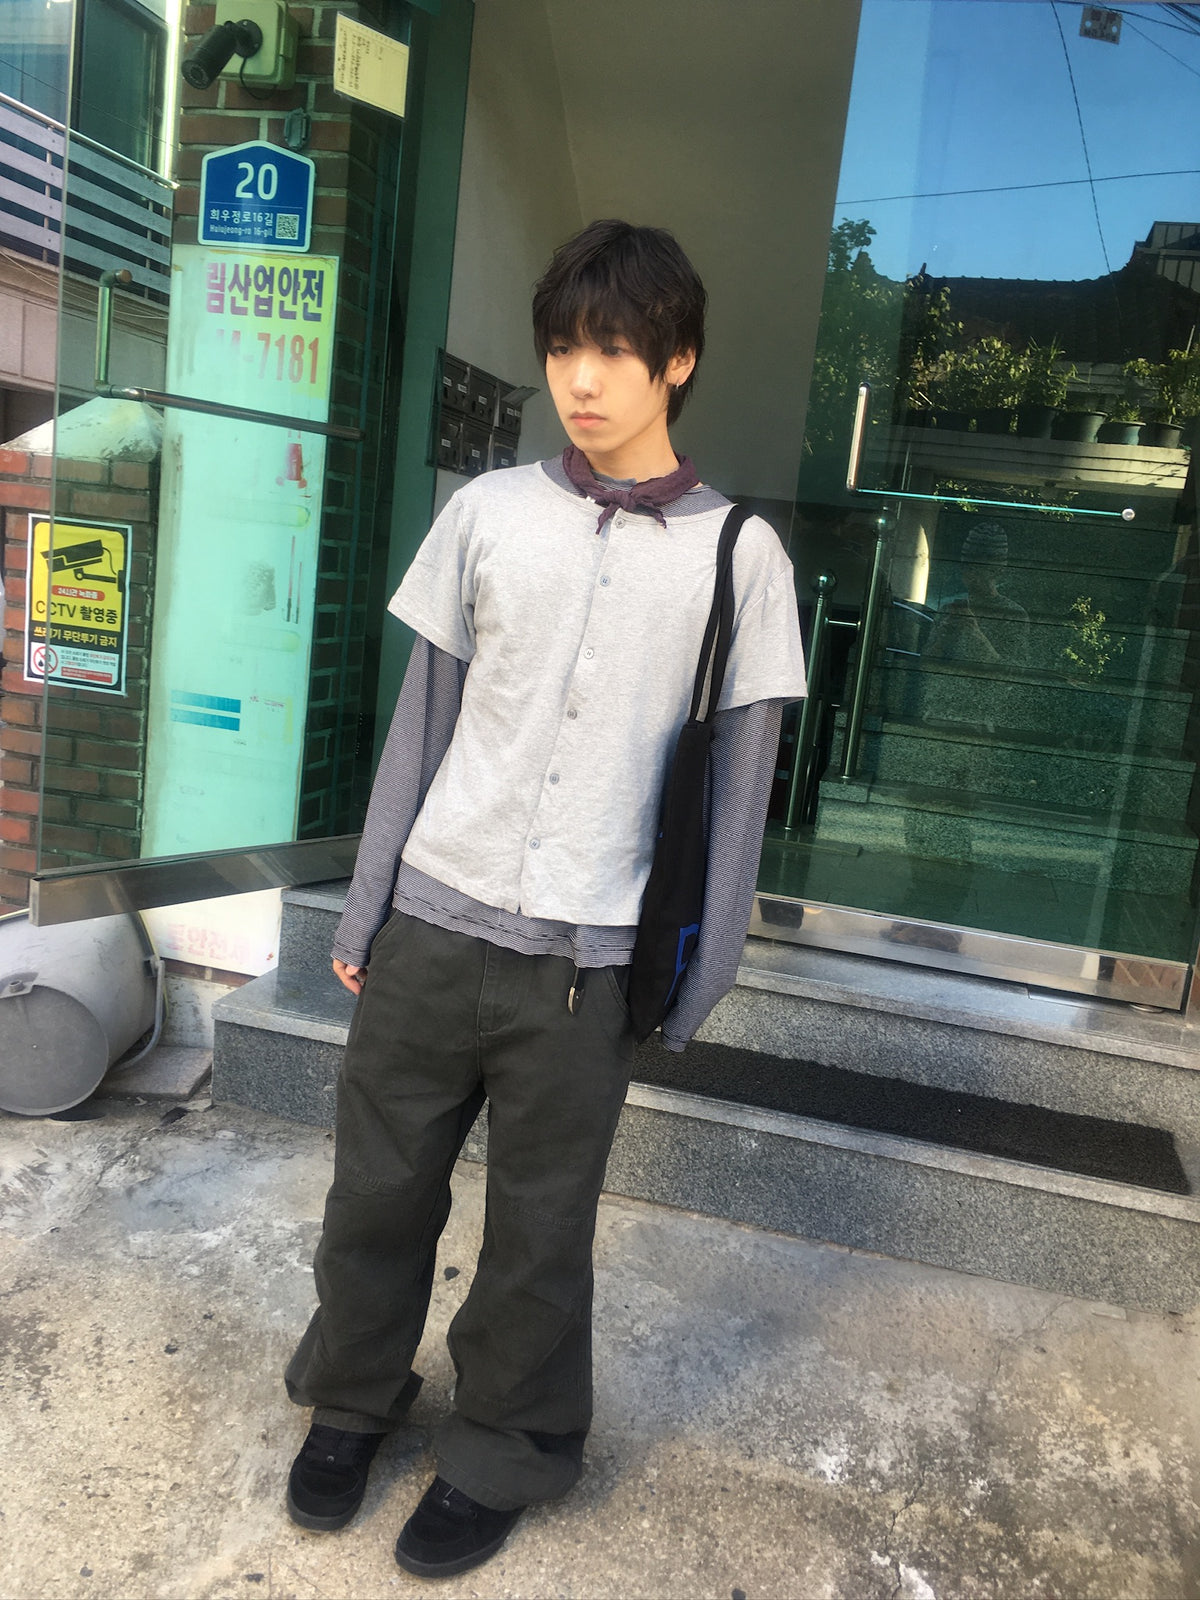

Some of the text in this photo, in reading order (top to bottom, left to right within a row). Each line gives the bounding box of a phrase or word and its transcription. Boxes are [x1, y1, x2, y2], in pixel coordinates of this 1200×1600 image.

[235, 161, 278, 201] 20
[209, 208, 274, 226] 희우정로16길
[35, 600, 118, 625] CCTV 촬영중
[62, 630, 98, 645] 무단투기
[99, 635, 118, 649] 금지
